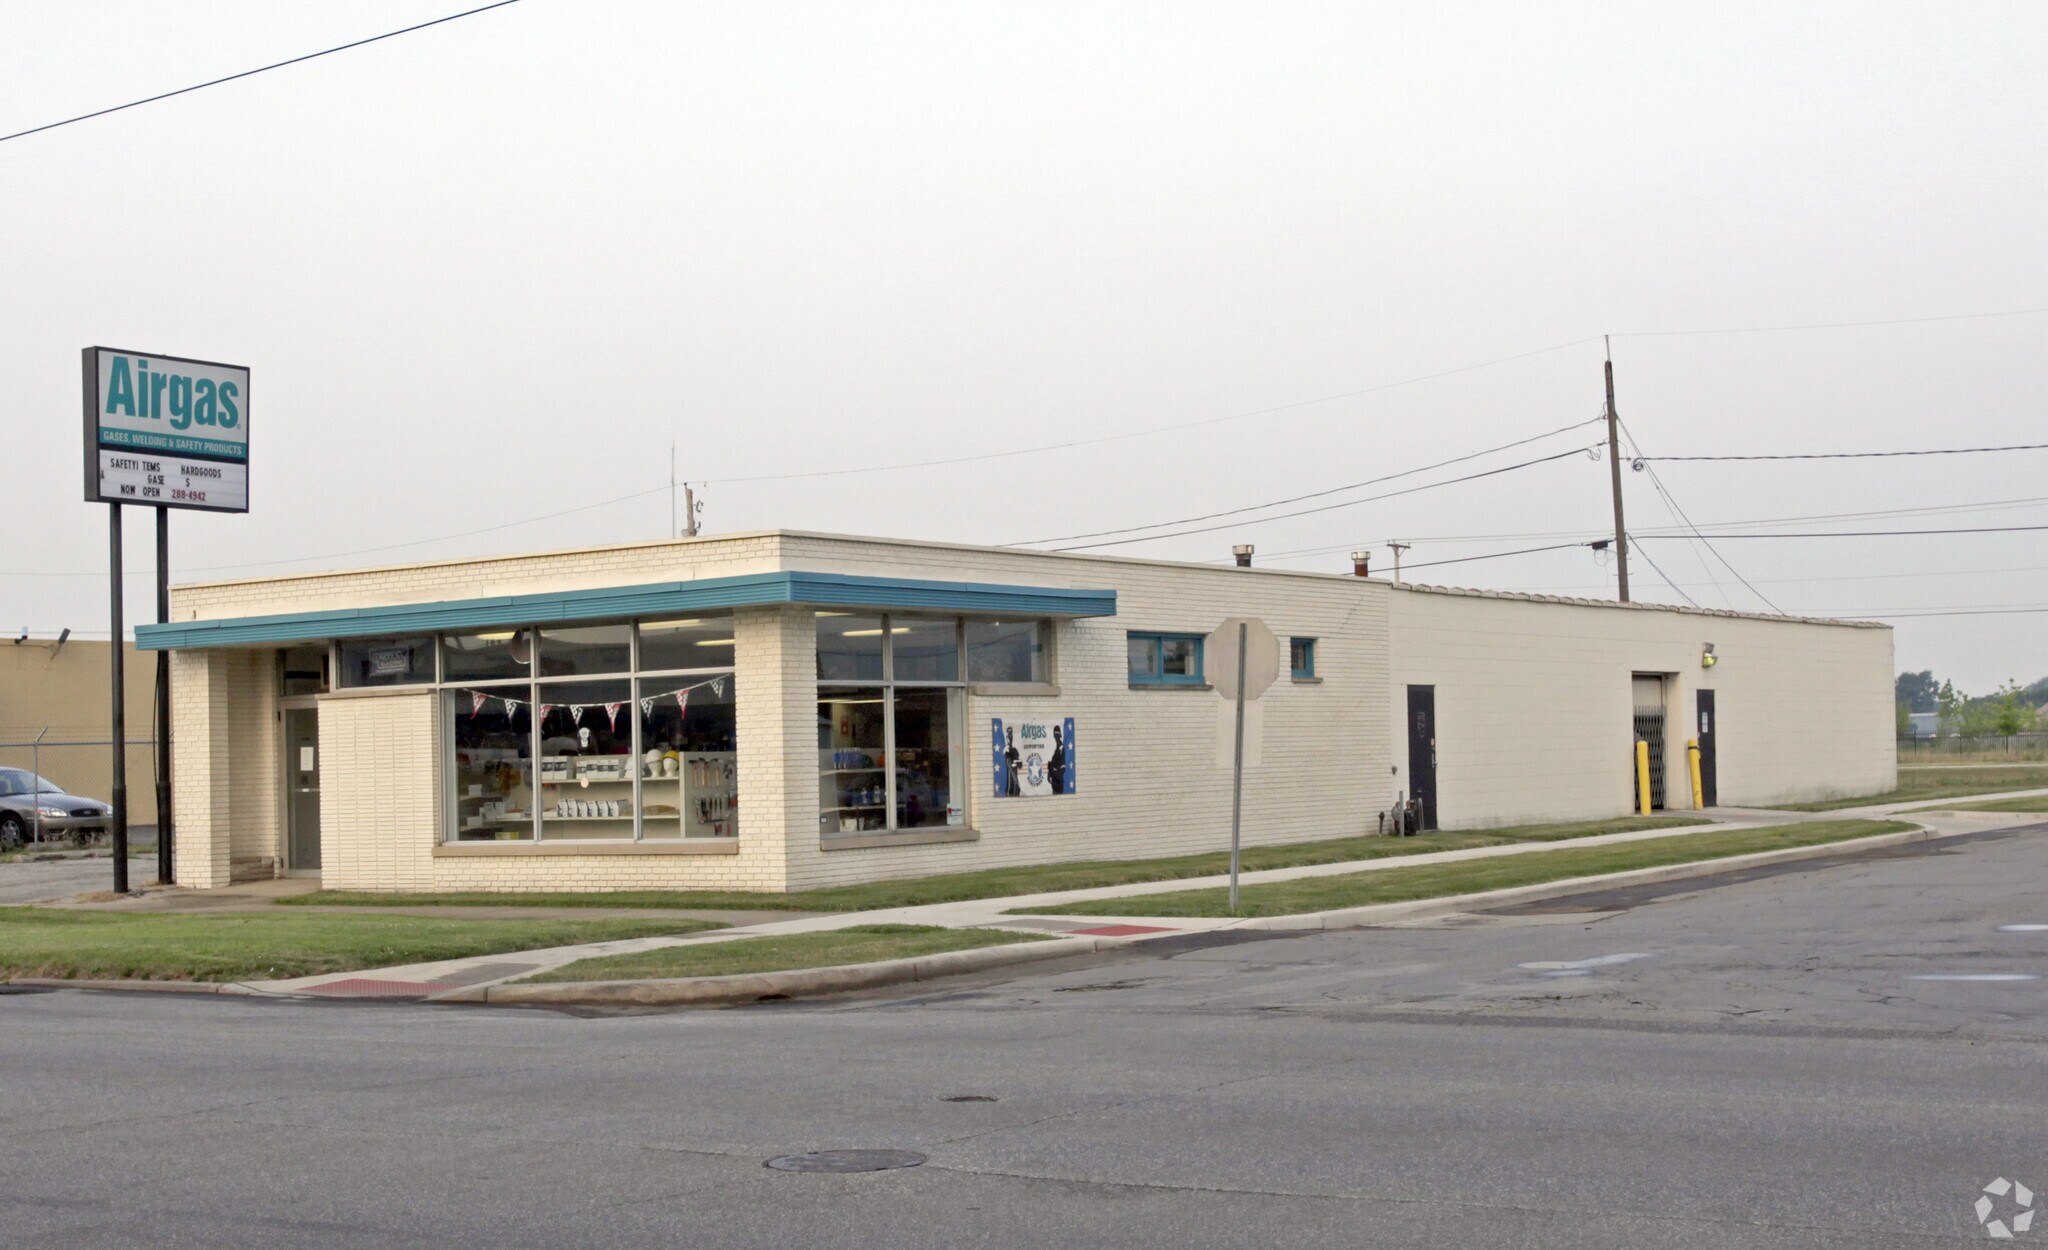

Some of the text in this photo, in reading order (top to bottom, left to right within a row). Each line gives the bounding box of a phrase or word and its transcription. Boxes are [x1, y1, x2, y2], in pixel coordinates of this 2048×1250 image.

[106, 355, 239, 430] Airgas
[132, 434, 167, 447] WELDING
[168, 438, 174, 448] &
[175, 439, 203, 451] SAFETY
[204, 442, 242, 455] PRODUCTS
[180, 465, 222, 478] HARDGOODS
[120, 484, 206, 501] NOW OPEN 288-4942
[1021, 723, 1047, 740] Airgas
